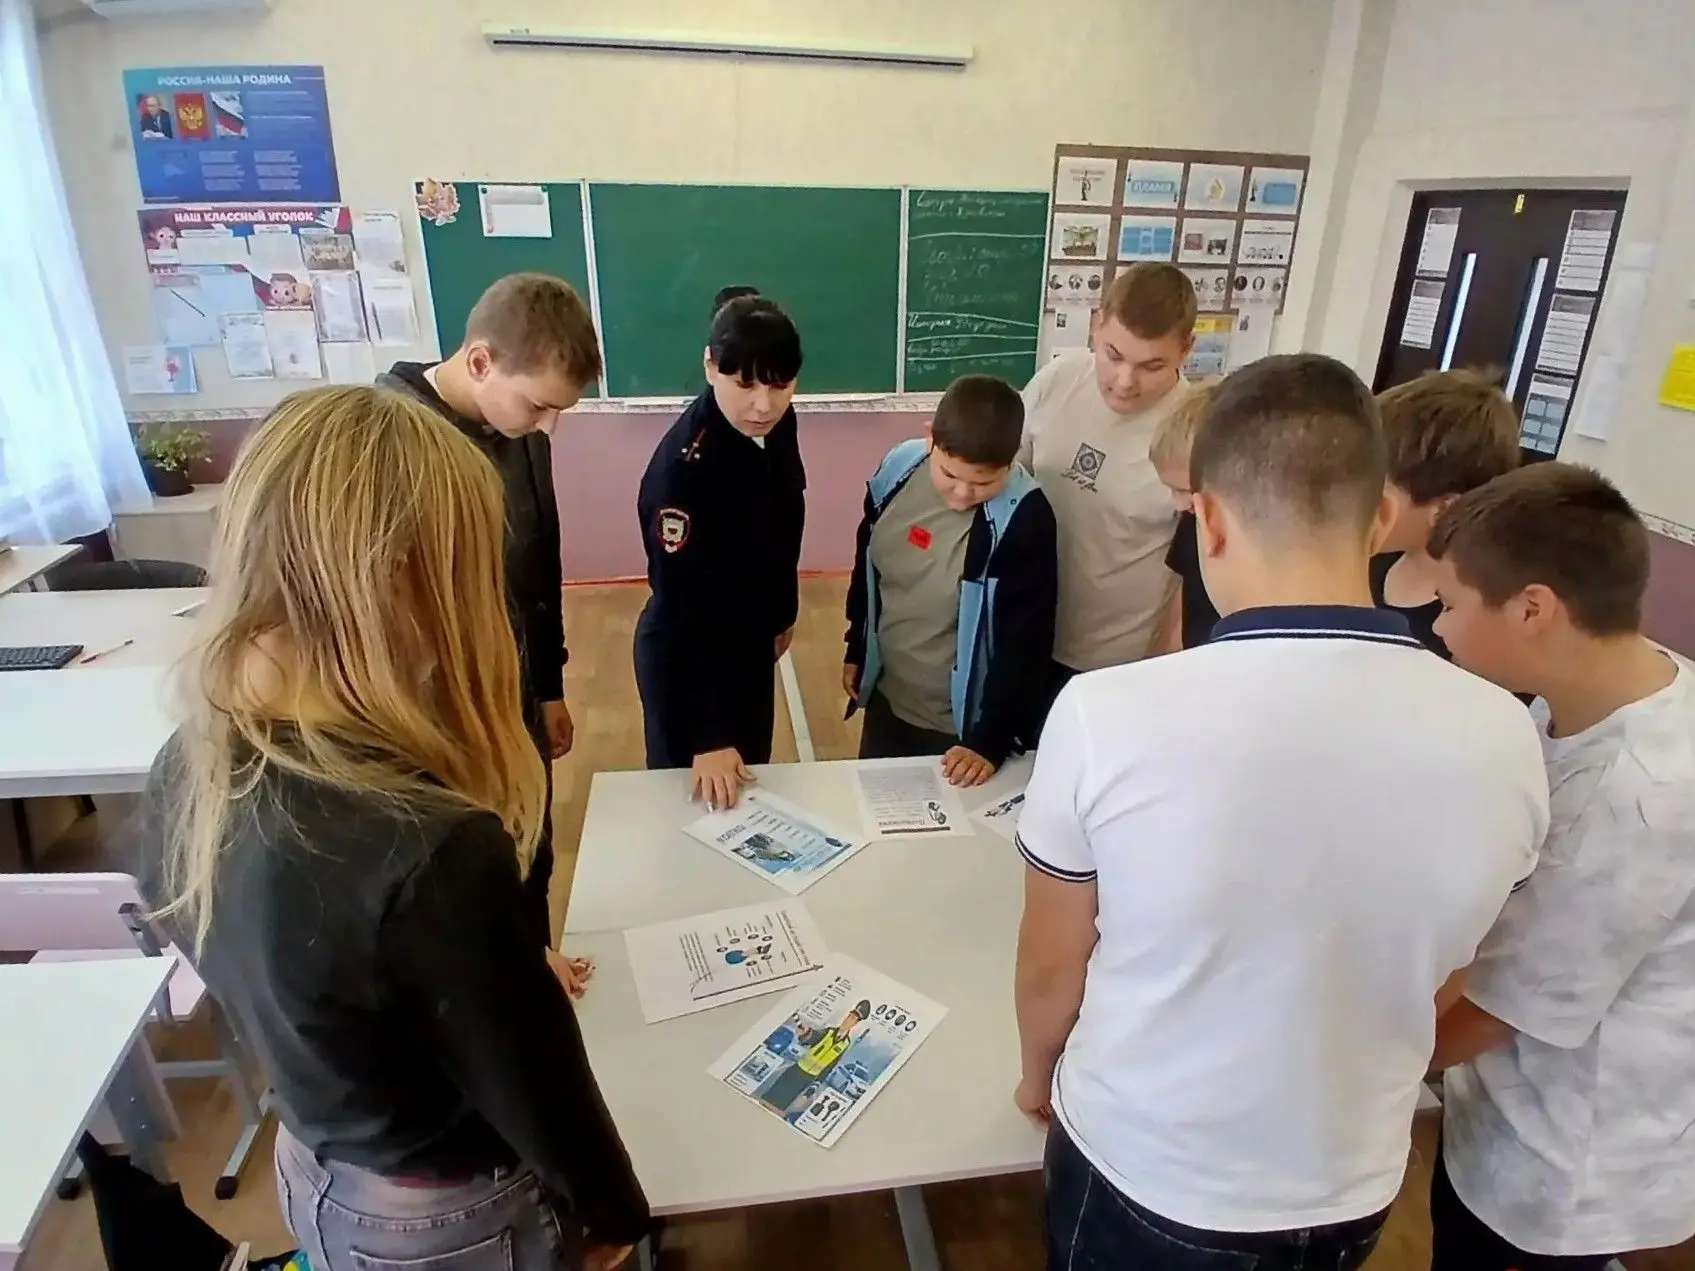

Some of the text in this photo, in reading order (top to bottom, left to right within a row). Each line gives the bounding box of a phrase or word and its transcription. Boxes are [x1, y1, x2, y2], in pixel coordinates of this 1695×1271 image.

[242, 75, 292, 85] РОДИНА
[174, 210, 314, 223] НАШ КЛАССНЫЙ УГОЛОК
